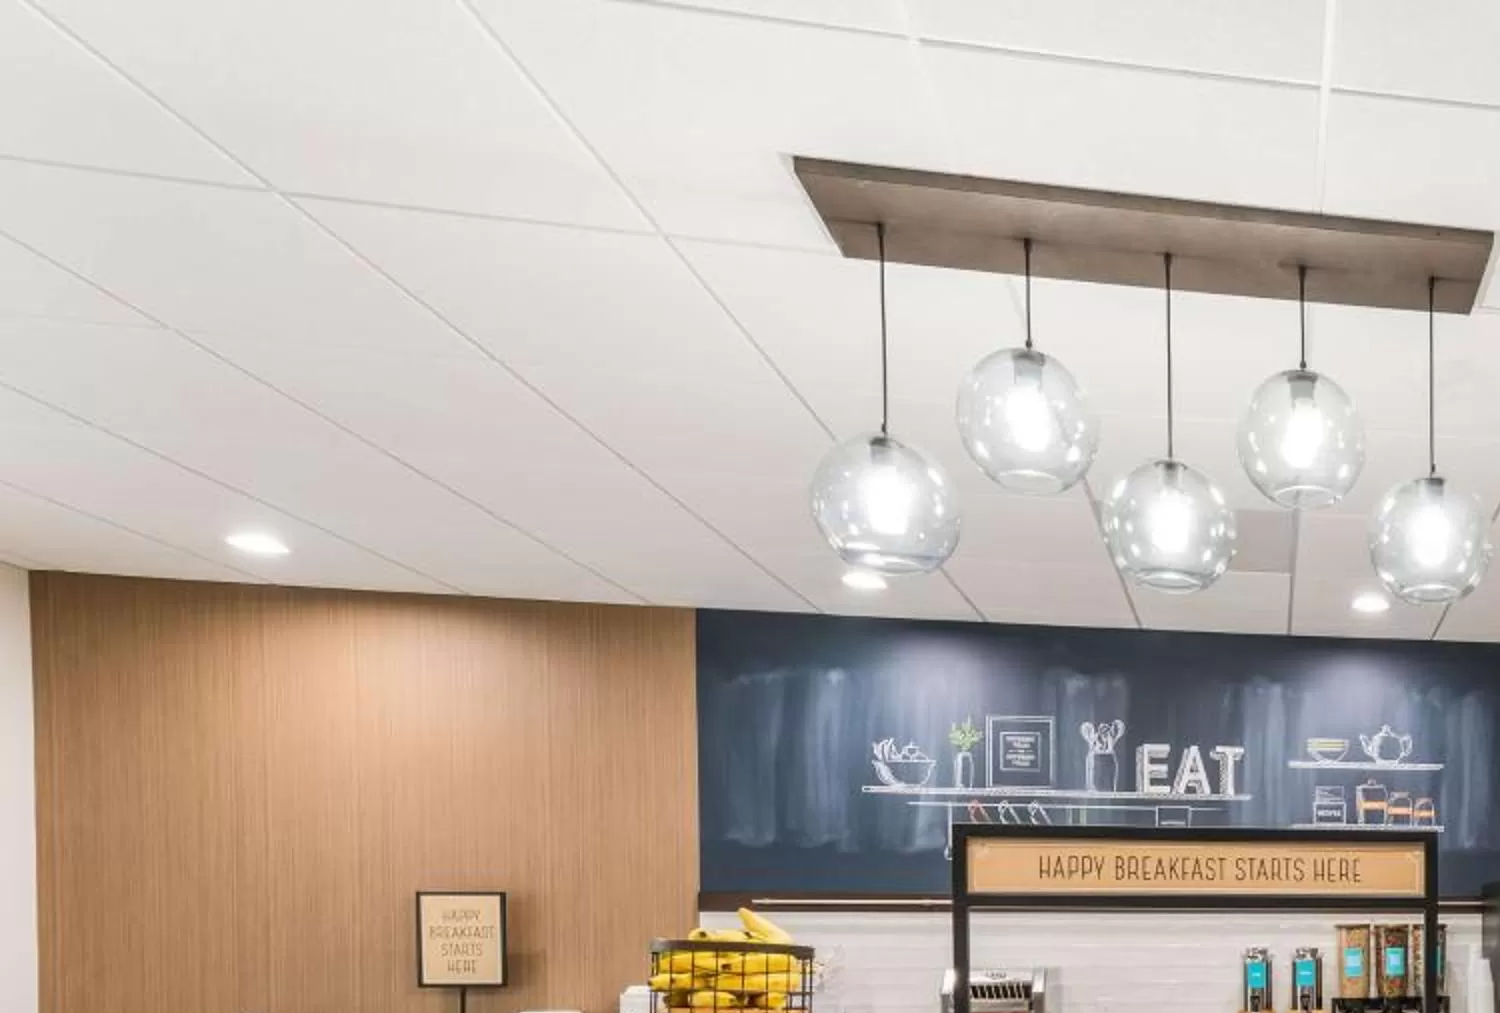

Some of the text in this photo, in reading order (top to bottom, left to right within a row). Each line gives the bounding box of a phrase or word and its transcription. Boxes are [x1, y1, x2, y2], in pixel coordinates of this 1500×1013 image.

[1135, 742, 1245, 797] EAT
[1038, 855, 1361, 883] HAPPY BREAKFAST STARTS HERE
[440, 943, 483, 957] STARTS
[447, 959, 477, 975] HERE
